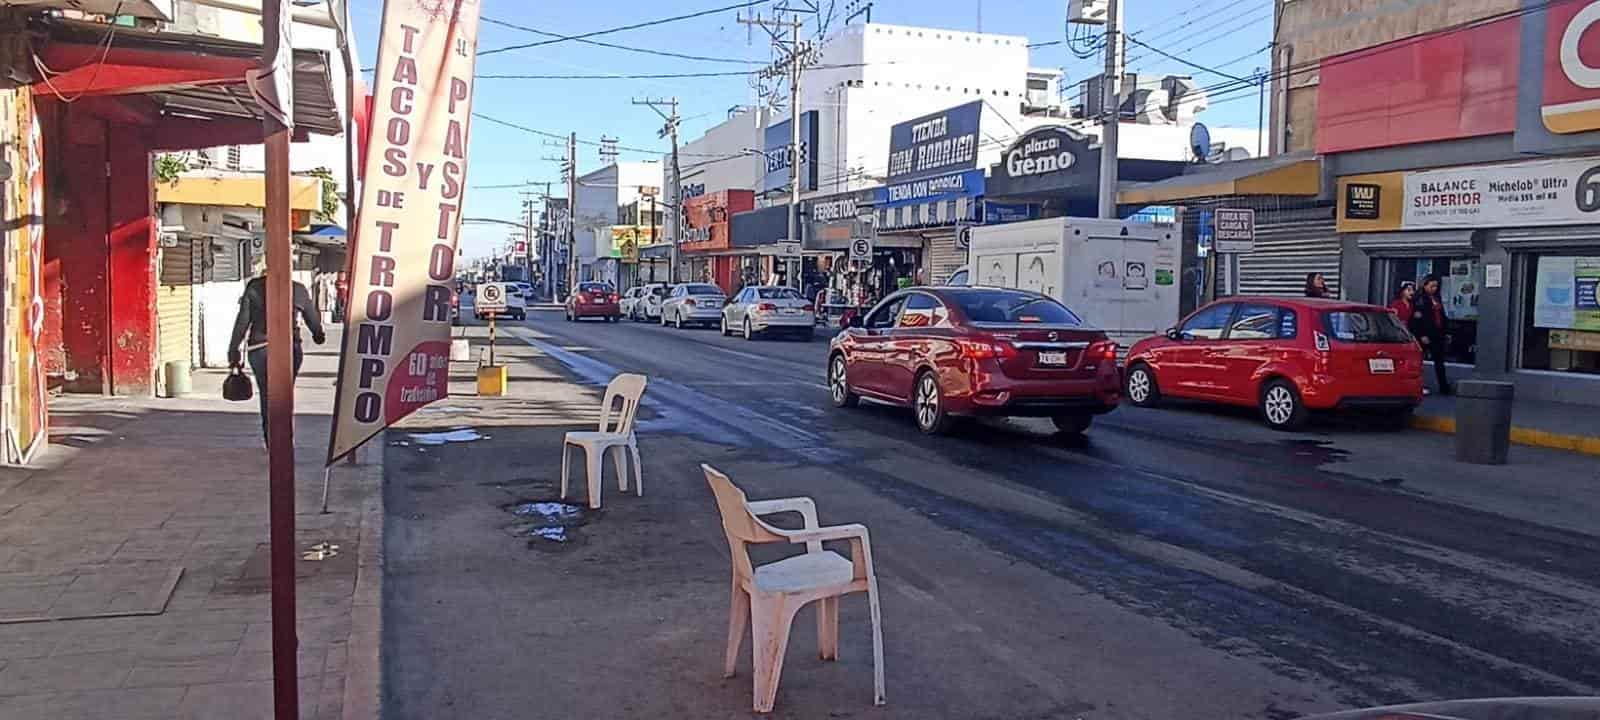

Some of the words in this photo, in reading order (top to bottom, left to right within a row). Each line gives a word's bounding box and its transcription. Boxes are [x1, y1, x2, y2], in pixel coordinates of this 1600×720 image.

[383, 24, 419, 177] TACOS
[911, 116, 947, 143] TIENDA
[763, 140, 807, 173] VERTICE
[889, 147, 912, 175] DON
[916, 134, 974, 170] RODRIGO
[1025, 136, 1059, 157] plaza
[416, 162, 434, 190] Y
[1007, 150, 1076, 177] Gemo
[888, 184, 912, 202] TIENDA
[913, 181, 928, 198] DON
[1421, 179, 1476, 193] BALANCE
[1542, 177, 1568, 189] Ultra
[376, 189, 405, 209] DE
[423, 76, 468, 321] PASTOR
[1413, 192, 1481, 208] SUPERIOR
[354, 220, 399, 424] TROMPO
[409, 352, 427, 376] 60
